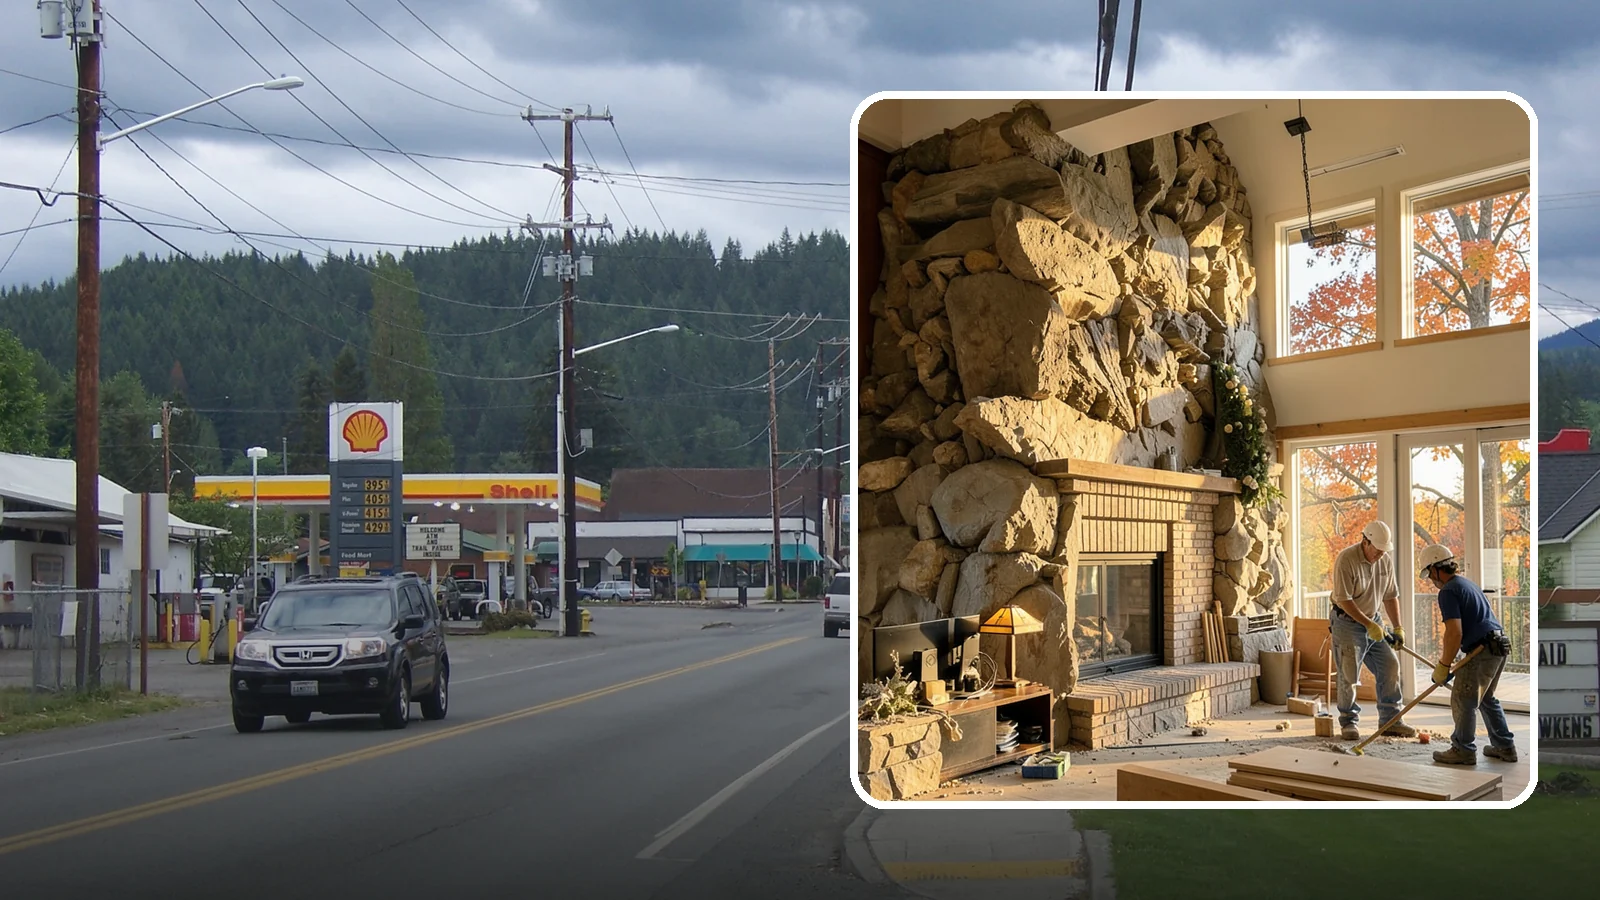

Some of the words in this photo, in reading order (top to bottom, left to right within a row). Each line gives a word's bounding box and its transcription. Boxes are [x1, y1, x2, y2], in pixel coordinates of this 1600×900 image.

[365, 480, 383, 490] 395
[490, 485, 547, 498] Shell
[365, 494, 383, 504] 405
[365, 508, 383, 518] 415
[365, 522, 383, 532] 429
[1539, 643, 1566, 665] AID
